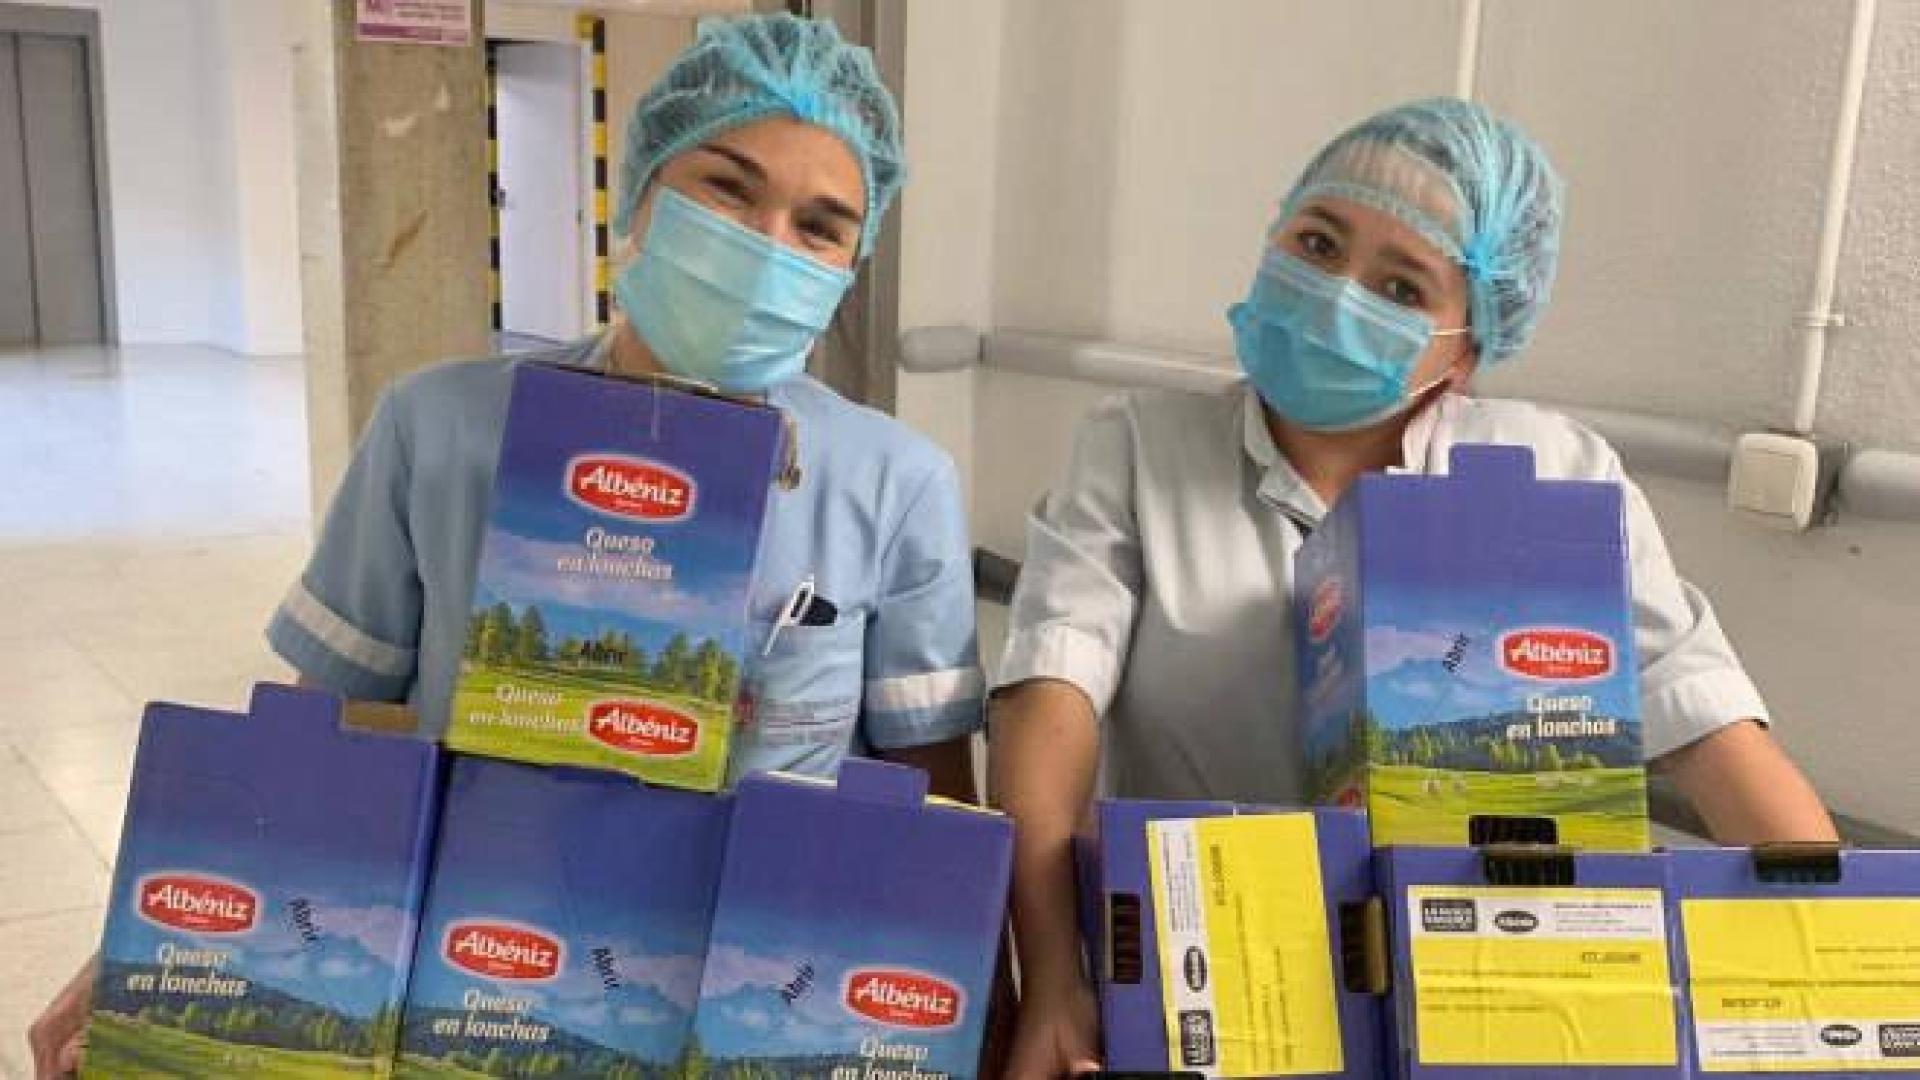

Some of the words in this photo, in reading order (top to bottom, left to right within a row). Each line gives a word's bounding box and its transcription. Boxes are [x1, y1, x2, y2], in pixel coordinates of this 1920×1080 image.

[579, 465, 684, 507] Albéniz
[586, 526, 655, 557] Queso
[1509, 636, 1607, 666] Albéniz
[1525, 694, 1593, 715] Queso
[595, 706, 691, 744] Albéniz
[1505, 723, 1532, 740] en
[1537, 711, 1616, 739] lonchas
[146, 883, 249, 921] Albéniz
[157, 942, 233, 969] Queso
[454, 930, 553, 968] Albéniz
[126, 973, 154, 991] en
[159, 967, 248, 997] lonchas
[854, 976, 953, 1015] Albéniz
[463, 989, 535, 1013] Queso
[432, 1017, 461, 1036] en
[464, 1011, 551, 1043] lonchas
[860, 1034, 929, 1064] Queso
